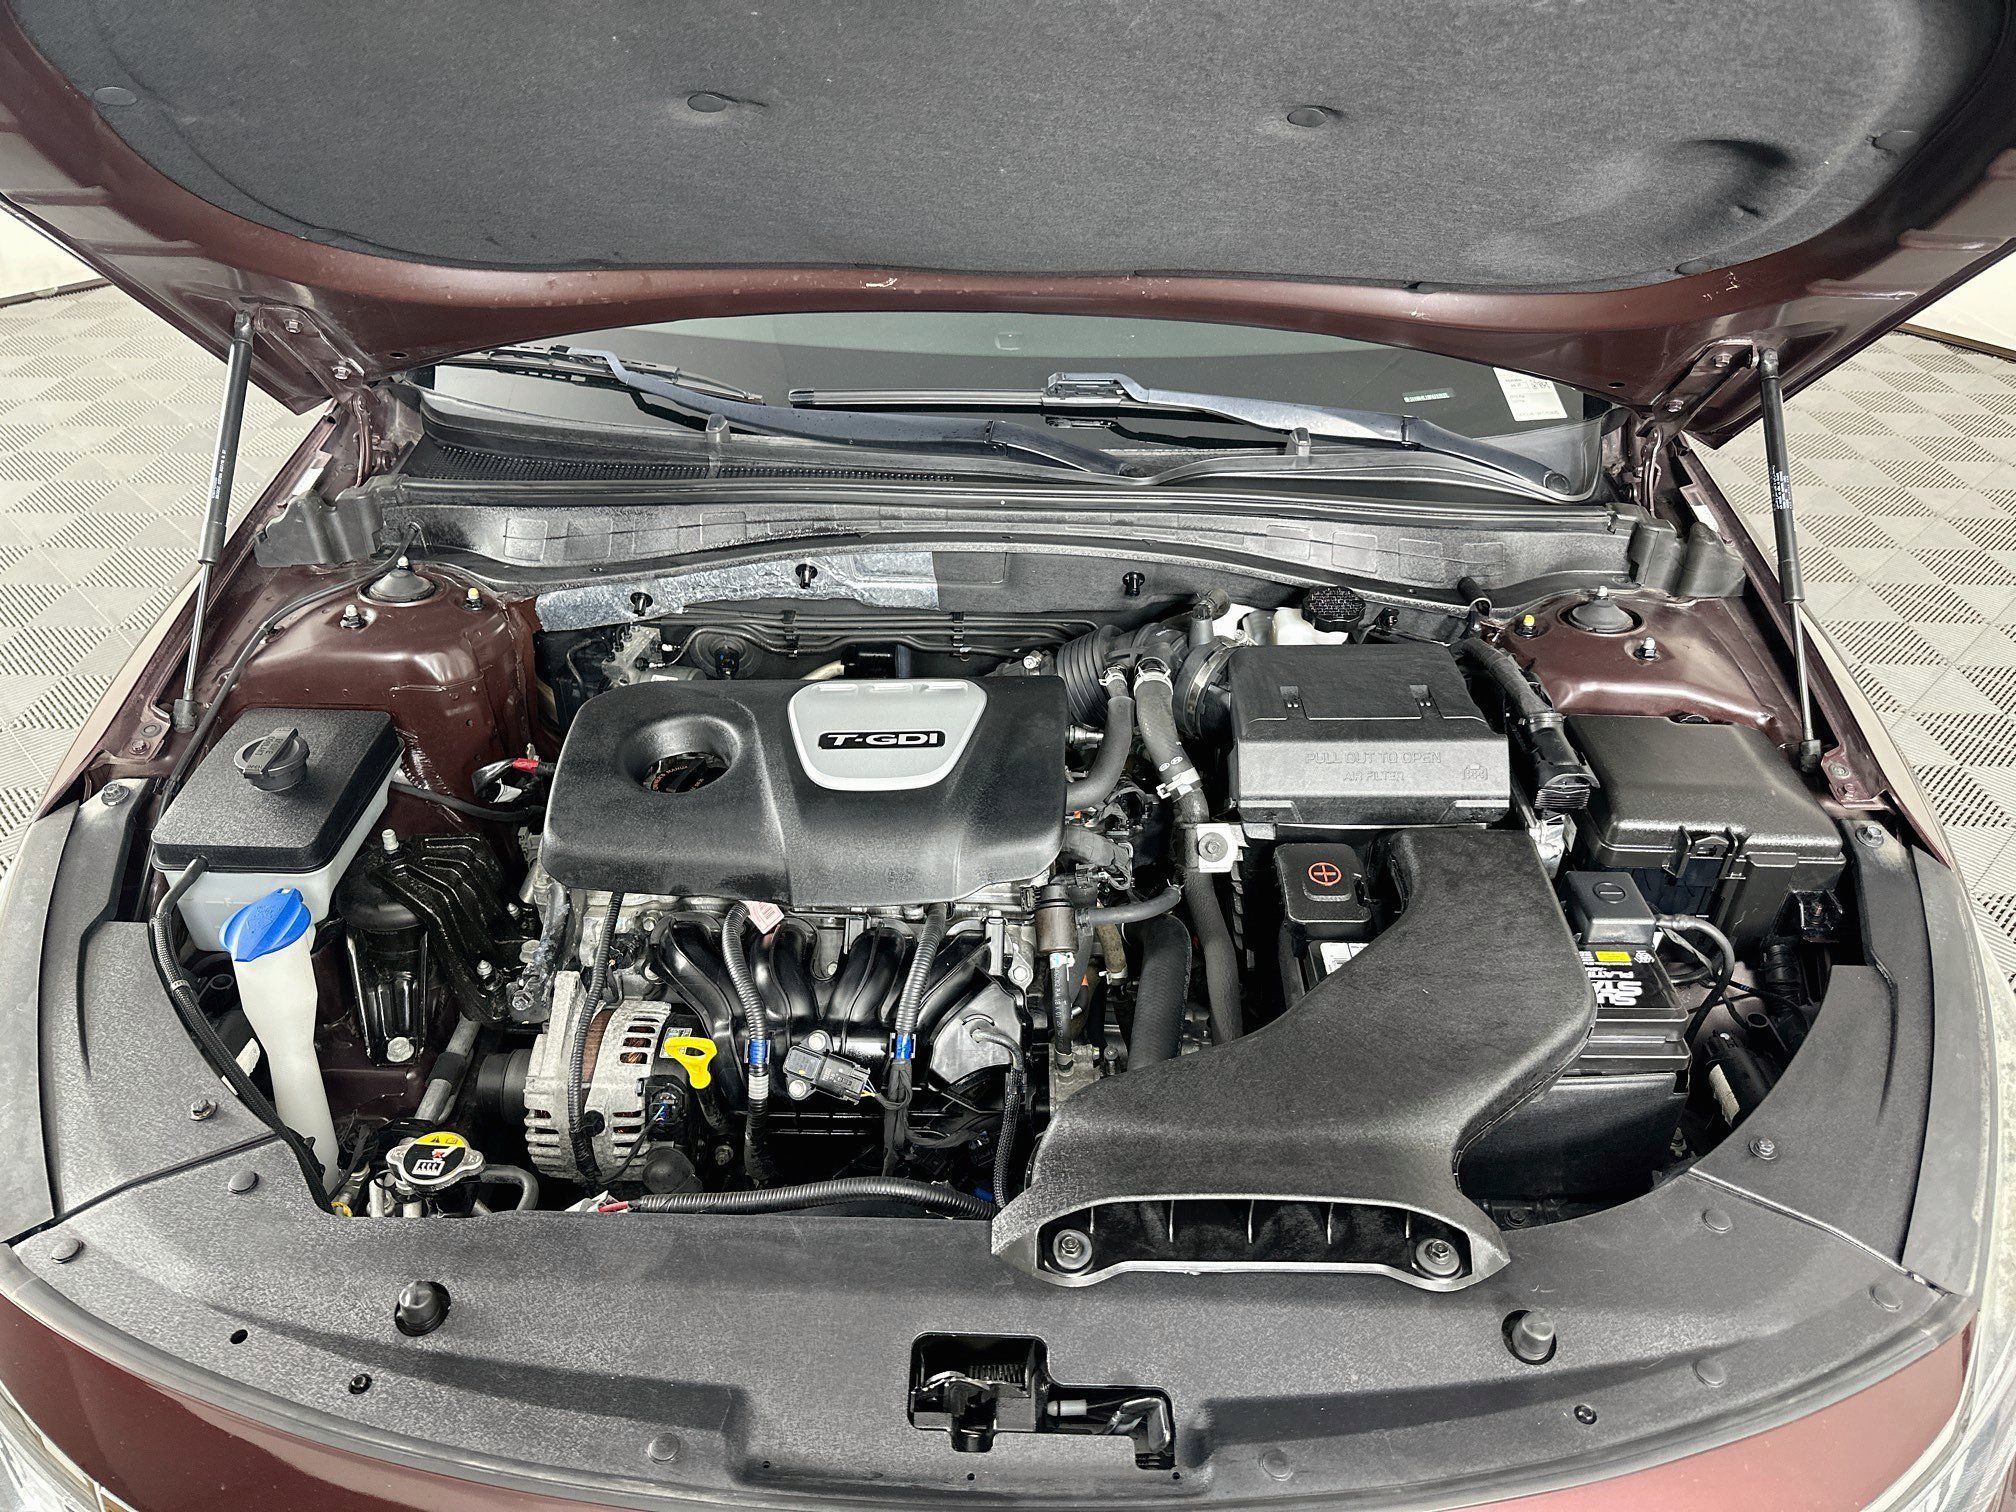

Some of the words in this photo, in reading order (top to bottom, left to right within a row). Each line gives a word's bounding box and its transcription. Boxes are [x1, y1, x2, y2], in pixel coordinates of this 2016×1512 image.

[827, 732, 939, 746] T-GDI
[1305, 752, 1342, 764] PULL
[1345, 752, 1375, 764] OUT
[1378, 752, 1397, 764] TO
[1401, 752, 1441, 764] OPEN
[1343, 771, 1363, 781] AIR
[1367, 770, 1404, 781] FILTER
